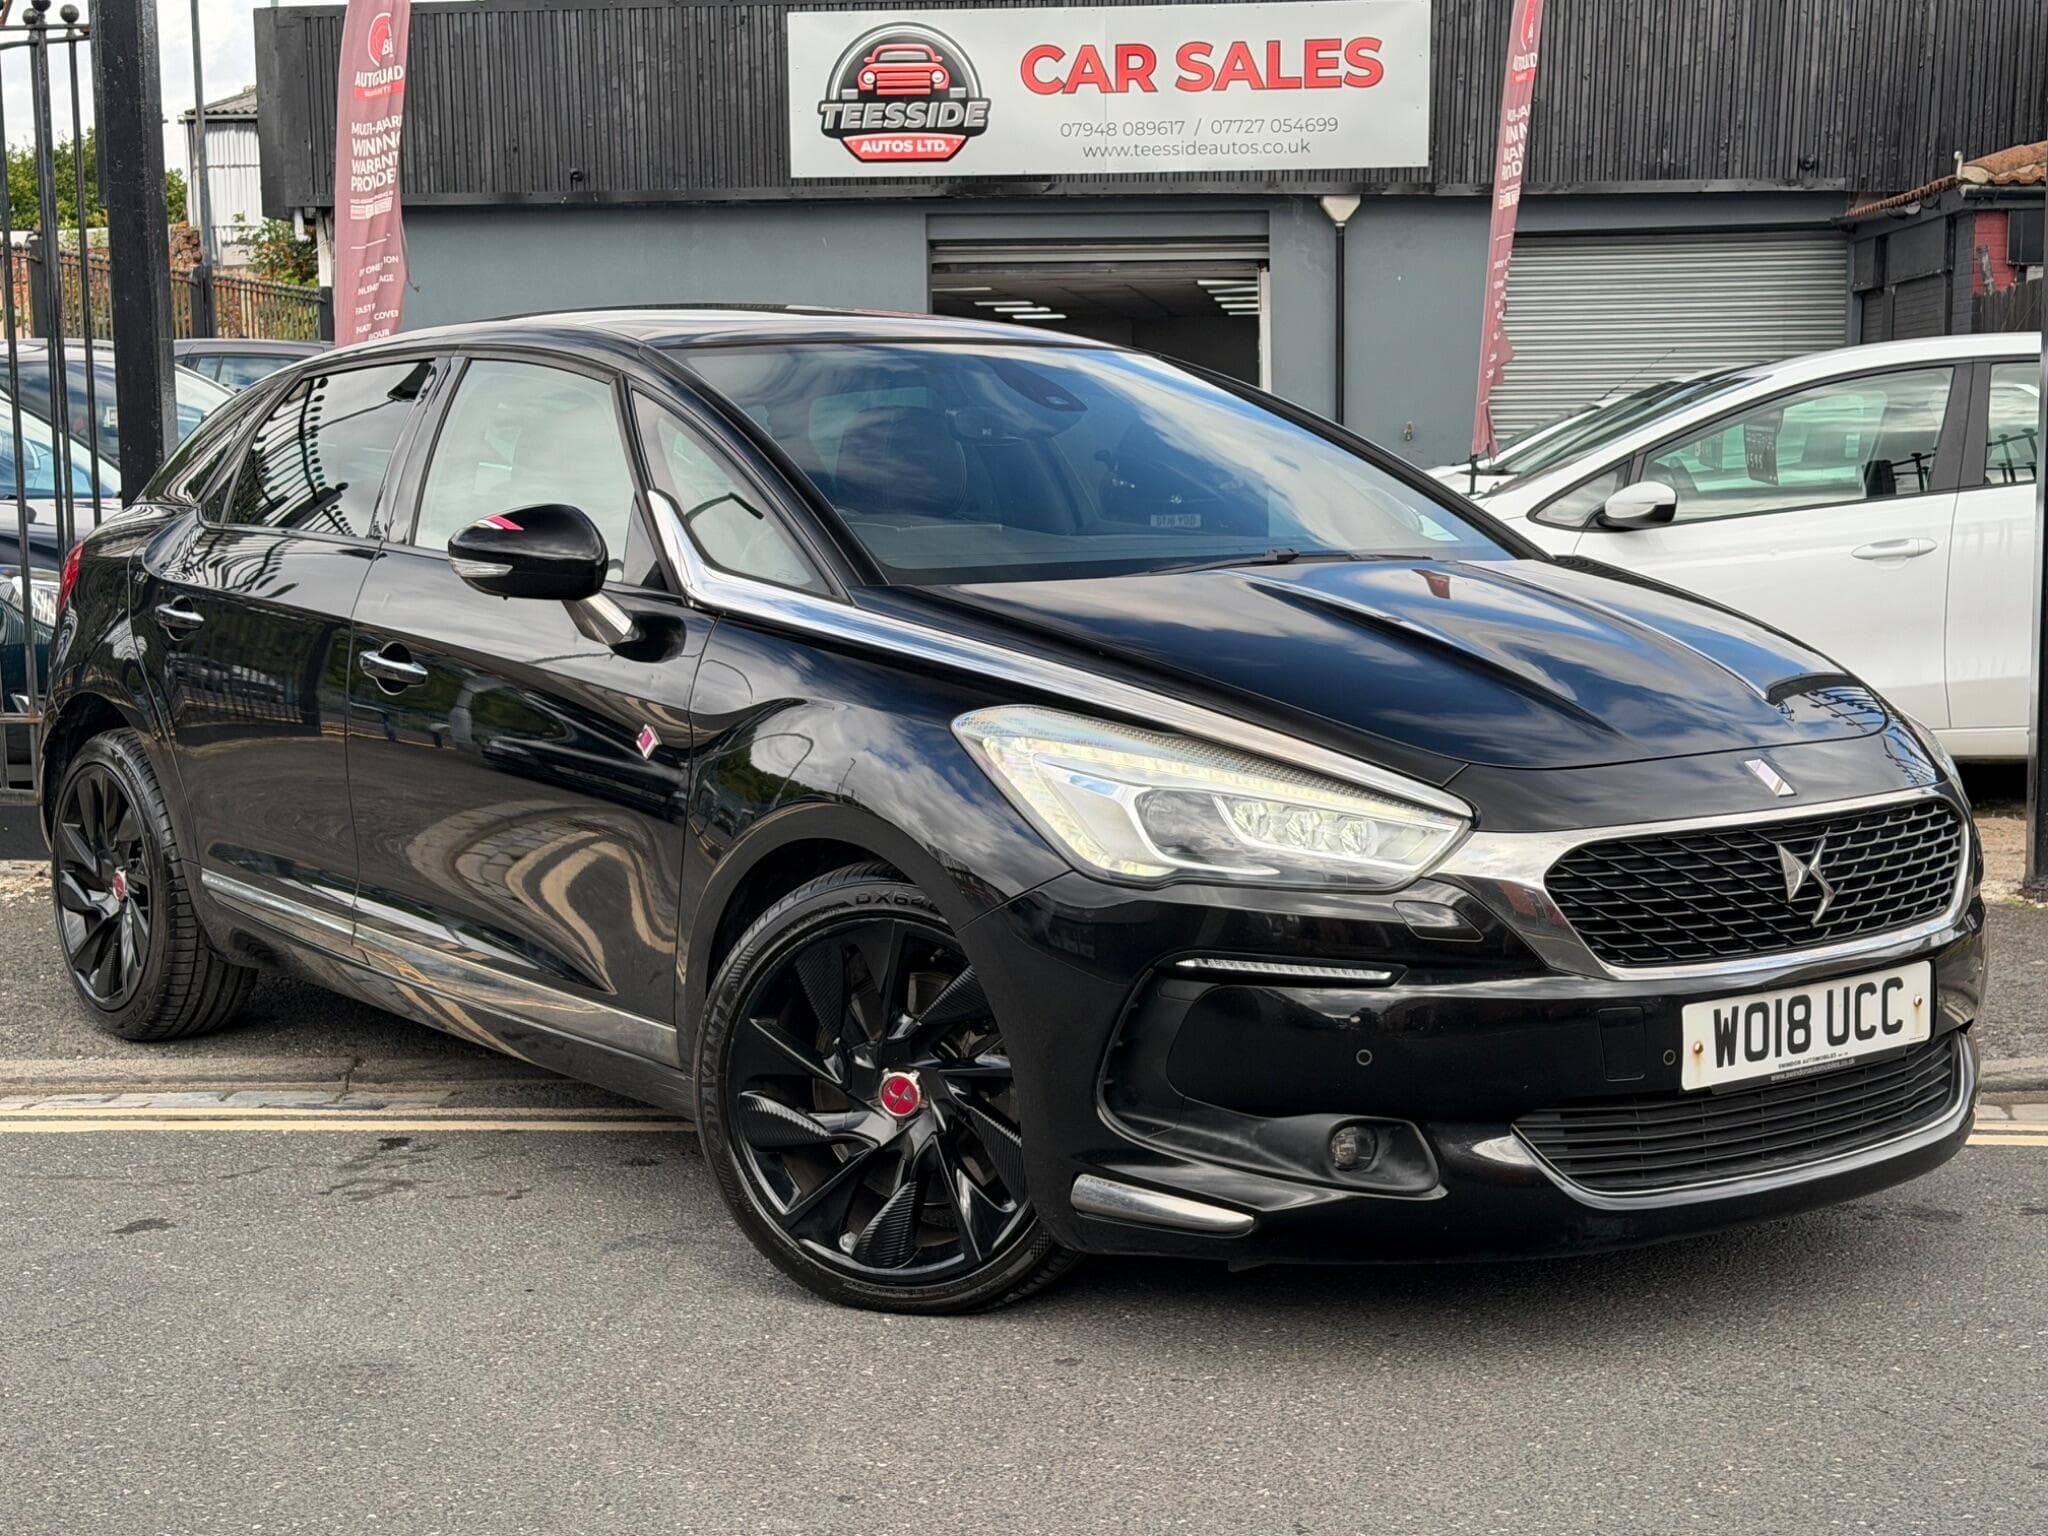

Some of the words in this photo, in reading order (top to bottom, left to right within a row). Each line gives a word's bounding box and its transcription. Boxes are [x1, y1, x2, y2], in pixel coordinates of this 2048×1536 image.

[1020, 43, 1159, 96] CAR
[1174, 36, 1385, 92] SALES
[820, 101, 989, 130] TEESSIDE
[1059, 121, 1118, 138] 07948
[1122, 120, 1185, 136] 089617
[1194, 117, 1203, 137] /
[1210, 118, 1265, 135] 07727
[1270, 117, 1339, 134] 054699
[860, 139, 913, 153] AUTOS
[916, 139, 950, 153] LTD.
[1082, 138, 1311, 158] www.teessideautos.co.uk
[1713, 994, 1812, 1068] WO18
[1826, 976, 1904, 1047] UCC
